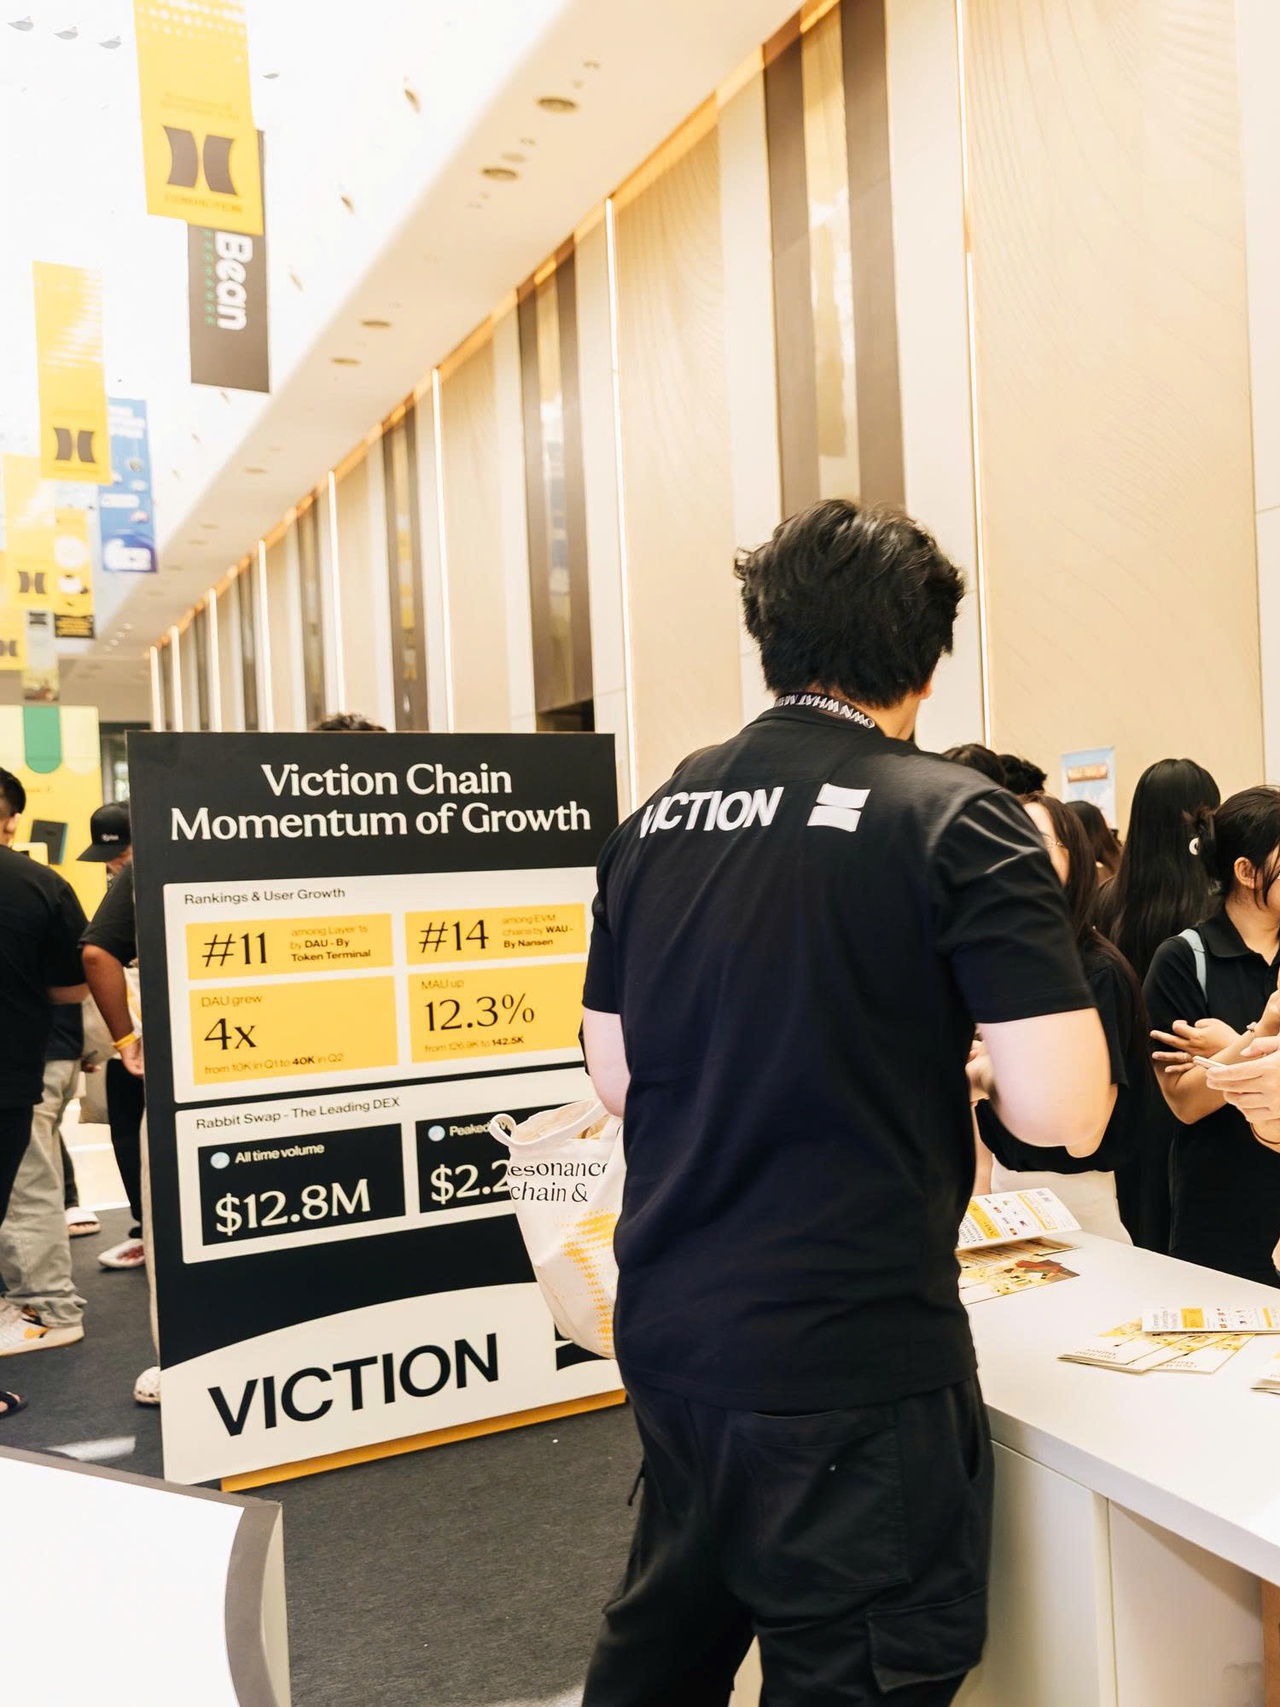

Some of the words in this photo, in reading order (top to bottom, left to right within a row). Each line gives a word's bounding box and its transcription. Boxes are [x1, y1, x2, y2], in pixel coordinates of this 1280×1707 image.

[215, 231, 253, 330] Bean
[796, 694, 839, 713] WHAT
[839, 704, 875, 729] OWN
[260, 763, 398, 796] Viction
[406, 762, 512, 795] Chain
[171, 806, 408, 841] Momentum
[415, 802, 458, 835] of
[461, 800, 592, 834] Growth
[639, 786, 785, 839] VICTION
[184, 892, 249, 906] Rankings
[251, 890, 260, 901] &
[264, 888, 294, 901] User
[297, 887, 346, 900] Growth
[502, 915, 534, 925] among
[535, 913, 557, 923] EVM
[291, 926, 327, 938] among
[328, 924, 355, 937] Layer
[418, 919, 490, 953] #14
[502, 927, 531, 936] chains
[532, 925, 544, 936] by
[545, 925, 568, 934] WAU
[202, 931, 268, 968] #11
[290, 940, 302, 951] by
[304, 937, 329, 949] DAU
[336, 938, 350, 950] By
[503, 940, 515, 949] By
[518, 937, 554, 948] Nansen
[291, 950, 324, 962] Token
[326, 948, 371, 960] Terminal
[421, 980, 449, 991] MAU
[451, 979, 465, 988] up
[201, 995, 230, 1008] DAU
[232, 994, 263, 1007] grew
[425, 993, 536, 1032] 12.3%
[204, 1018, 258, 1051] 4x
[425, 1043, 448, 1053] from
[492, 1035, 525, 1047] 142.5K
[205, 1063, 230, 1075] from
[232, 1060, 252, 1072] 10K
[253, 1060, 263, 1070] in
[280, 1057, 291, 1068] to
[292, 1055, 316, 1066] 40K
[317, 1055, 327, 1064] in
[328, 1052, 345, 1064] Q2
[196, 1115, 241, 1131] Rabbit
[244, 1109, 282, 1124] Swap
[291, 1106, 317, 1119] The
[320, 1099, 371, 1116] Leading
[373, 1096, 401, 1109] DEX
[449, 1121, 491, 1137] Peaked
[235, 1149, 252, 1164] All
[252, 1147, 280, 1162] time
[281, 1142, 326, 1158] volume
[507, 1161, 609, 1177] esonanc
[511, 1181, 567, 1202] chain
[571, 1182, 588, 1203] &
[215, 1178, 372, 1237] $12.8M
[207, 1332, 499, 1438] VICTION
